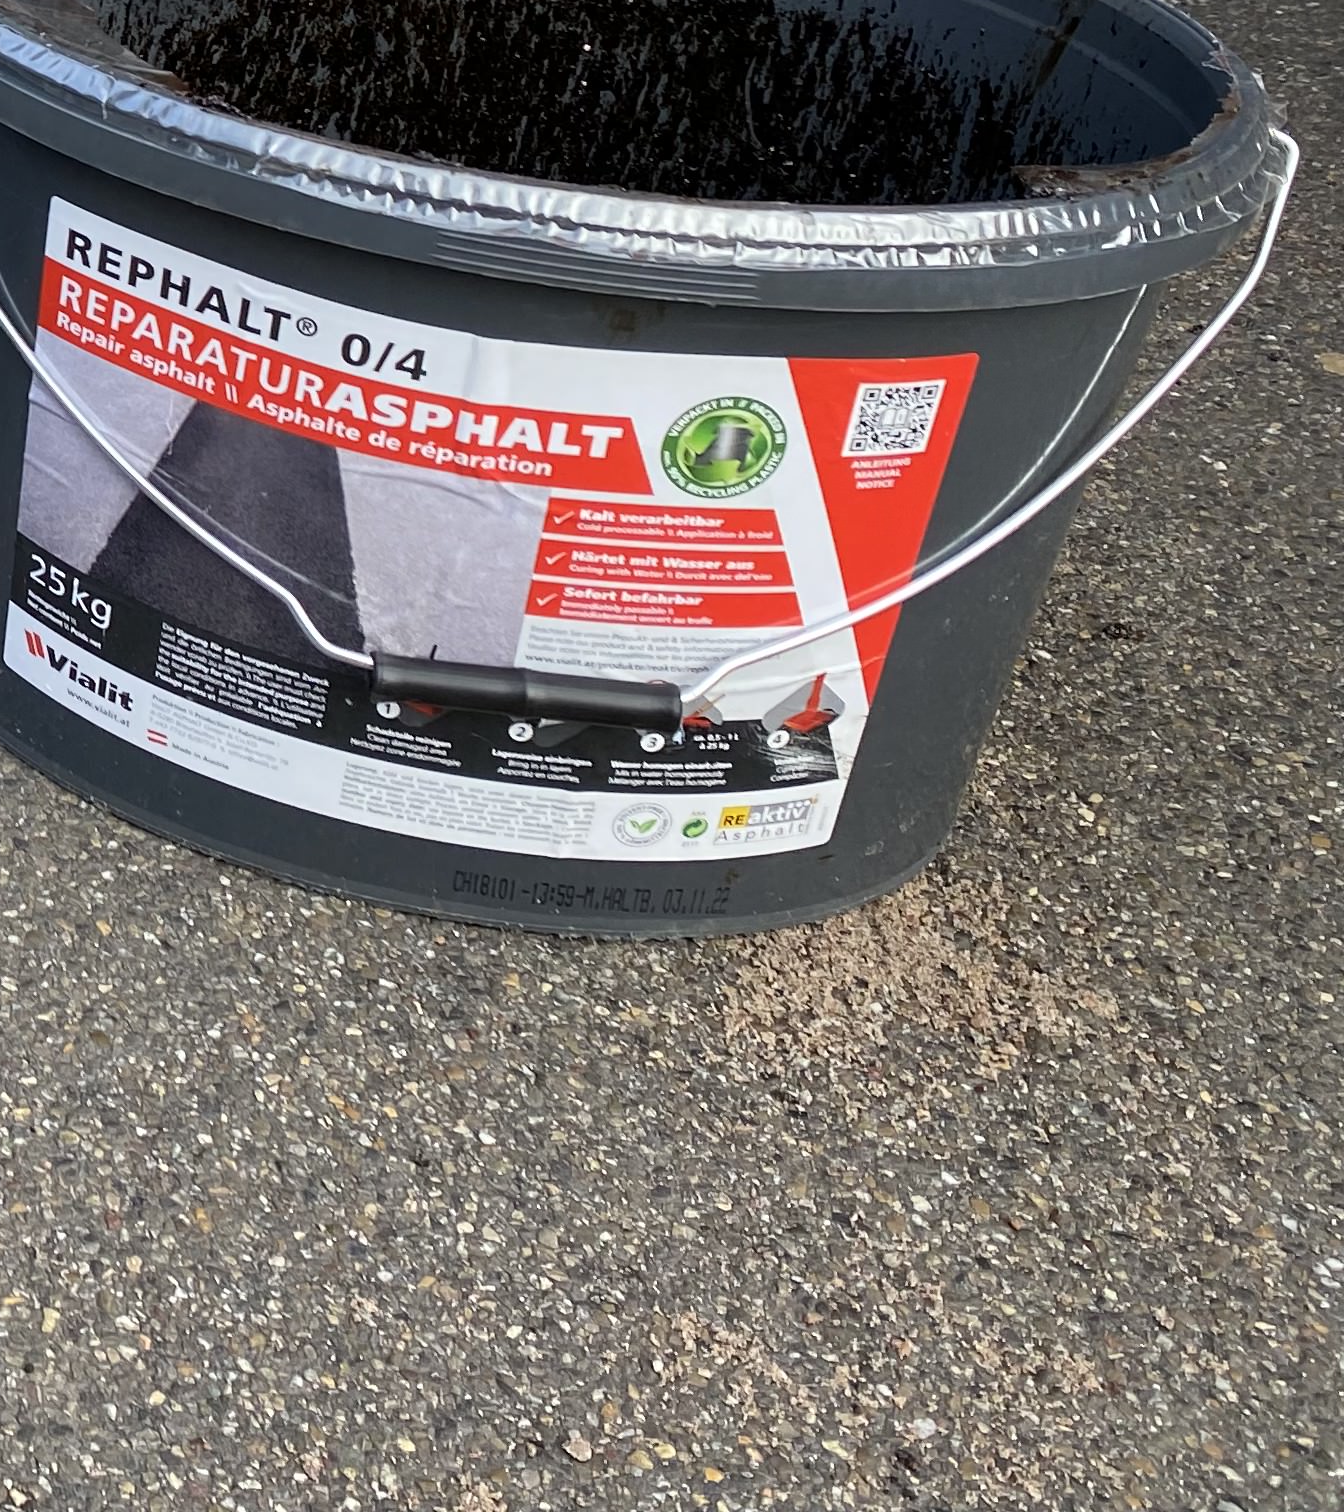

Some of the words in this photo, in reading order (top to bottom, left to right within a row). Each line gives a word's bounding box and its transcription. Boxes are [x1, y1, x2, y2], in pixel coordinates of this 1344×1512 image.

[66, 228, 318, 341] REPHALT®
[341, 333, 427, 381] 0/4
[59, 275, 624, 459] REPARATURASPHALT
[56, 311, 126, 355] Repair
[129, 347, 216, 396] asphalt
[247, 394, 362, 442] Asphalte
[368, 430, 402, 452] de
[409, 440, 553, 477] réparation
[748, 452, 782, 487] PLASTIC
[850, 457, 912, 469] ANLEITUNG
[854, 468, 902, 480] MANUAL
[855, 479, 895, 490] NOTICE
[579, 509, 615, 523] Kalt
[620, 512, 725, 528] verarbeitbar
[571, 550, 625, 566] Härtet
[630, 554, 659, 567] mit
[663, 557, 721, 570] Wasser
[725, 561, 755, 571] aus
[30, 554, 66, 596] 25
[71, 577, 112, 629] kg
[563, 587, 617, 602] Sofort
[621, 591, 704, 606] befahrbar
[46, 644, 134, 711] Vialit
[713, 823, 804, 842] Asphalt
